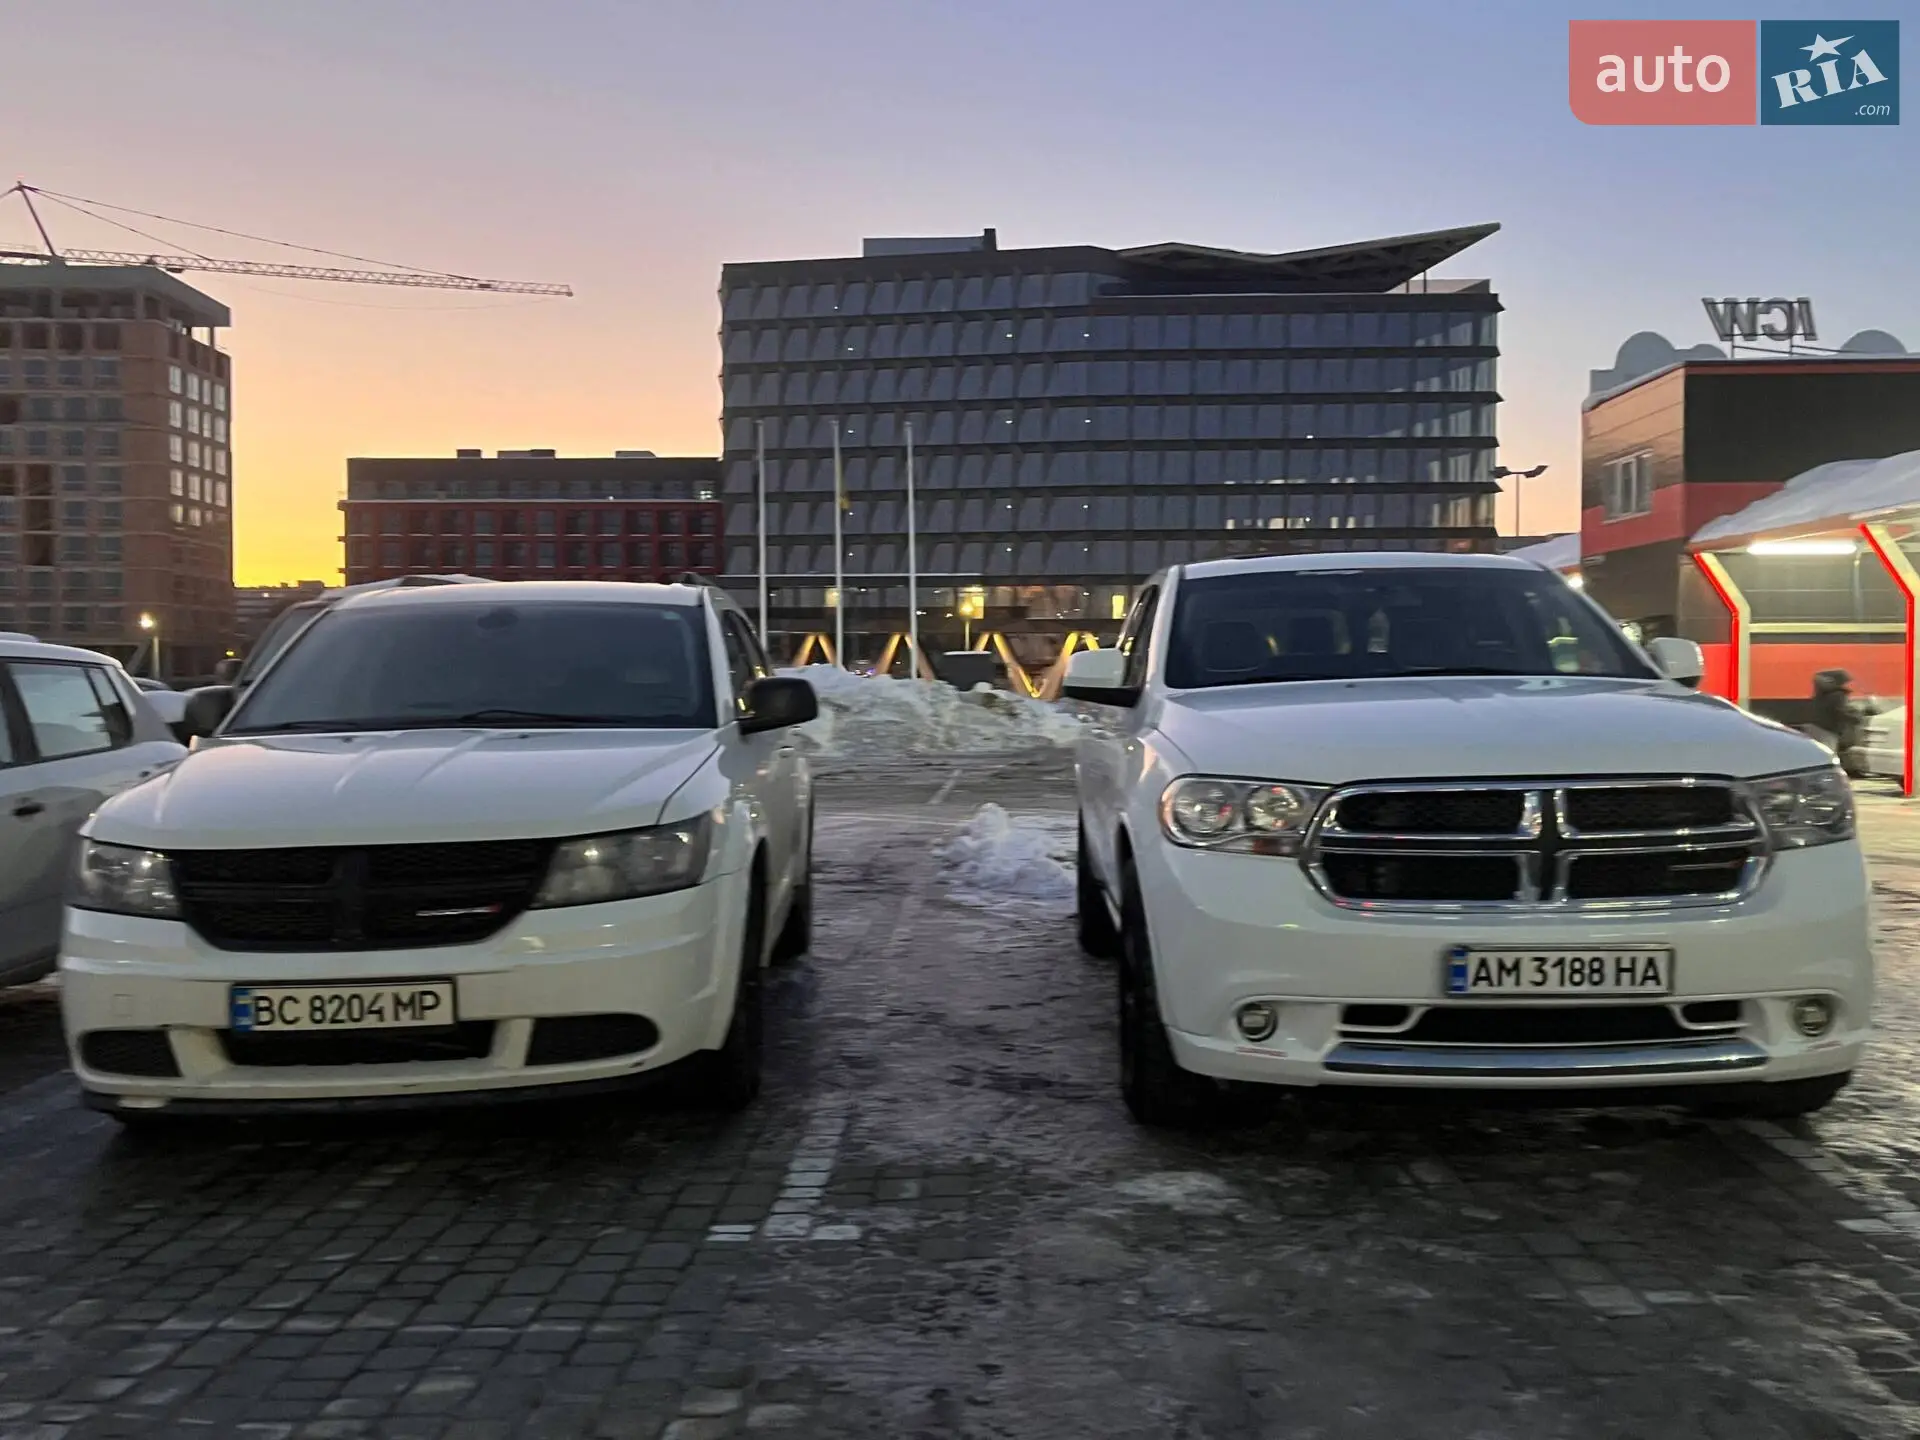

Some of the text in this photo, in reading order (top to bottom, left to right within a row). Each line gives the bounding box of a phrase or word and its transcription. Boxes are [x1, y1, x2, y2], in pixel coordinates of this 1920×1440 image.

[1471, 956, 1662, 987] AM 3188 HA
[254, 990, 442, 1026] BC 8204 MP
